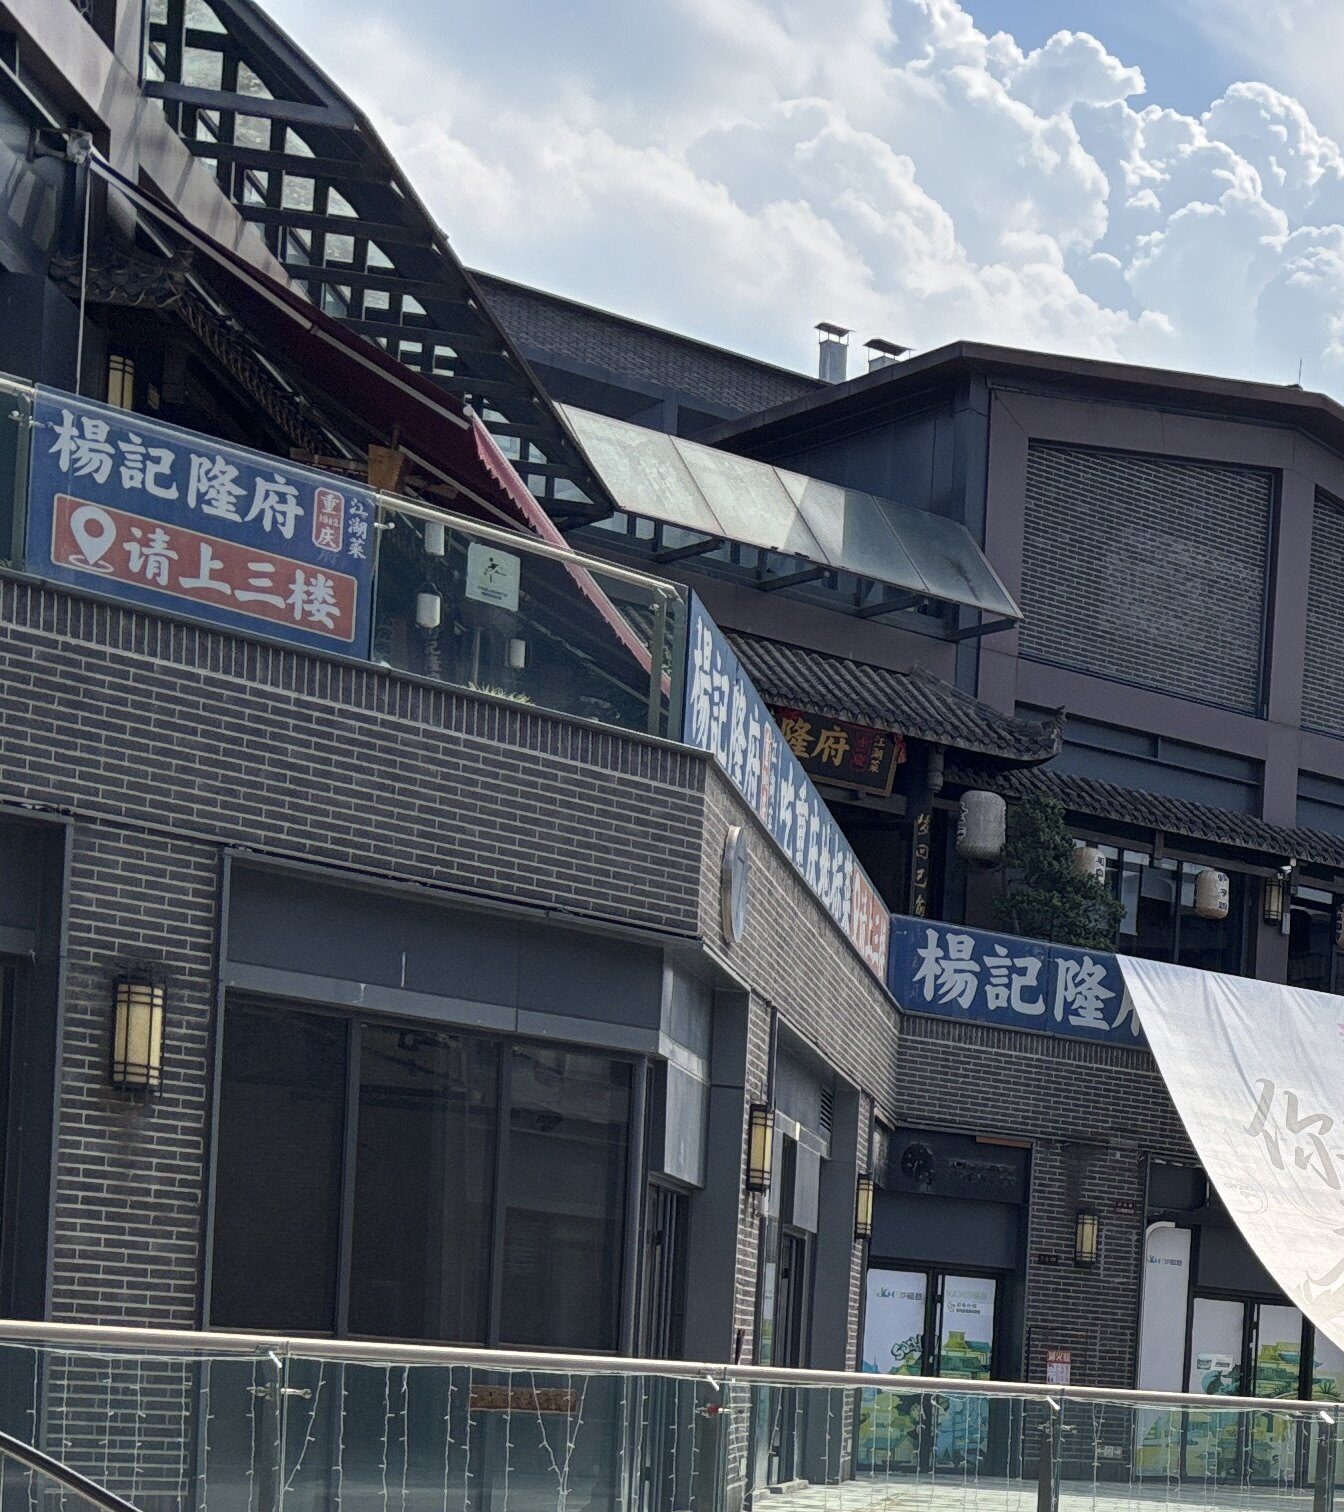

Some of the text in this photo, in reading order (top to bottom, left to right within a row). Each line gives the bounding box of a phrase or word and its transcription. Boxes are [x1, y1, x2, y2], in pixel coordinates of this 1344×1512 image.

[49, 409, 305, 539] 楊記隆府
[348, 498, 368, 559] 江湖菜
[123, 527, 341, 630] 请上三楼
[690, 616, 760, 812] 楊記隆府
